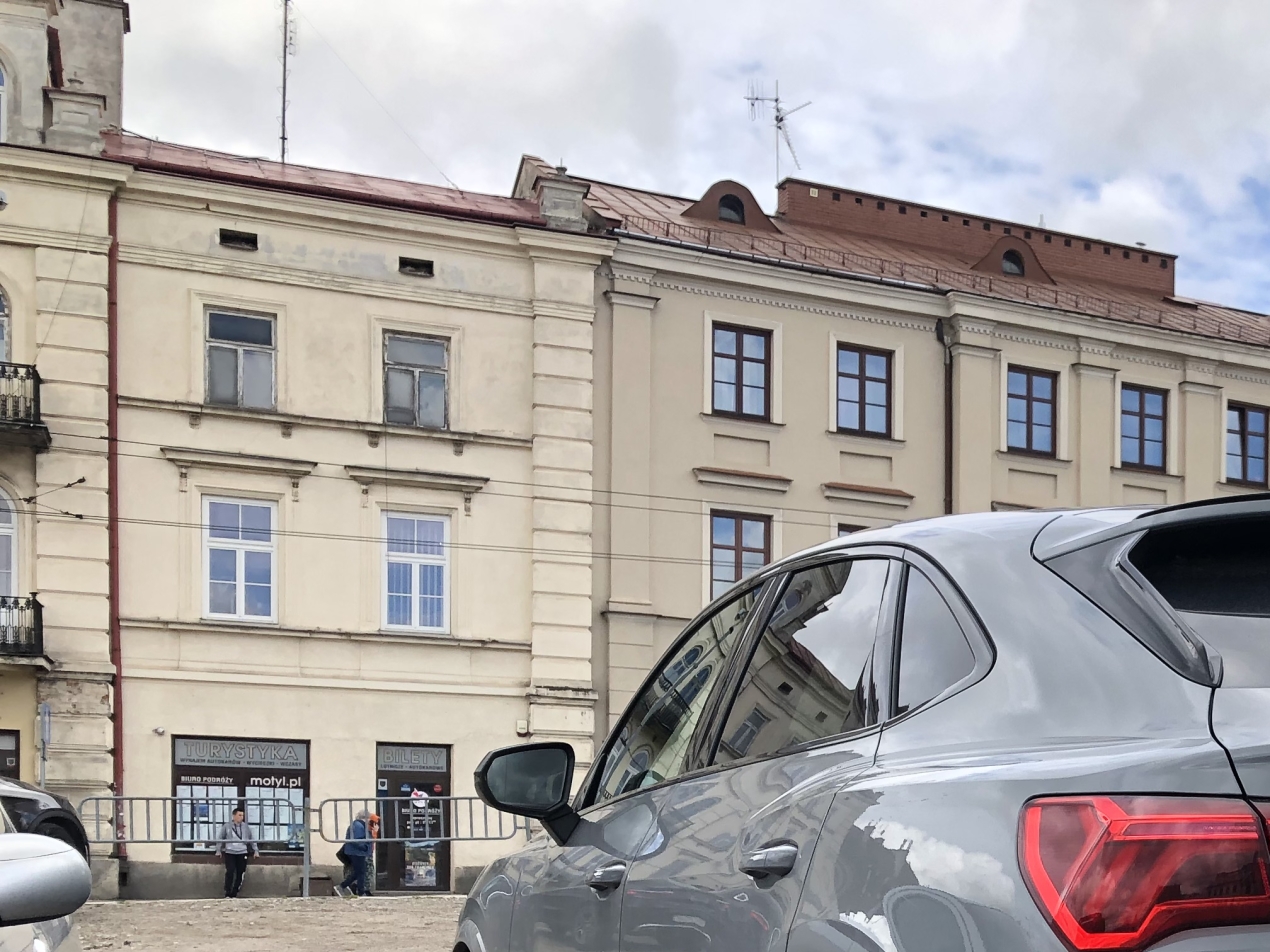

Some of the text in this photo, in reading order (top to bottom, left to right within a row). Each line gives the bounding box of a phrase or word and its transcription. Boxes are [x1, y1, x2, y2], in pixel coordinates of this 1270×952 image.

[184, 742, 299, 760] TURYSTYKA
[383, 748, 443, 765] BILETY
[203, 775, 234, 783] PODRÓŻY
[250, 776, 301, 788] motyl.pl
